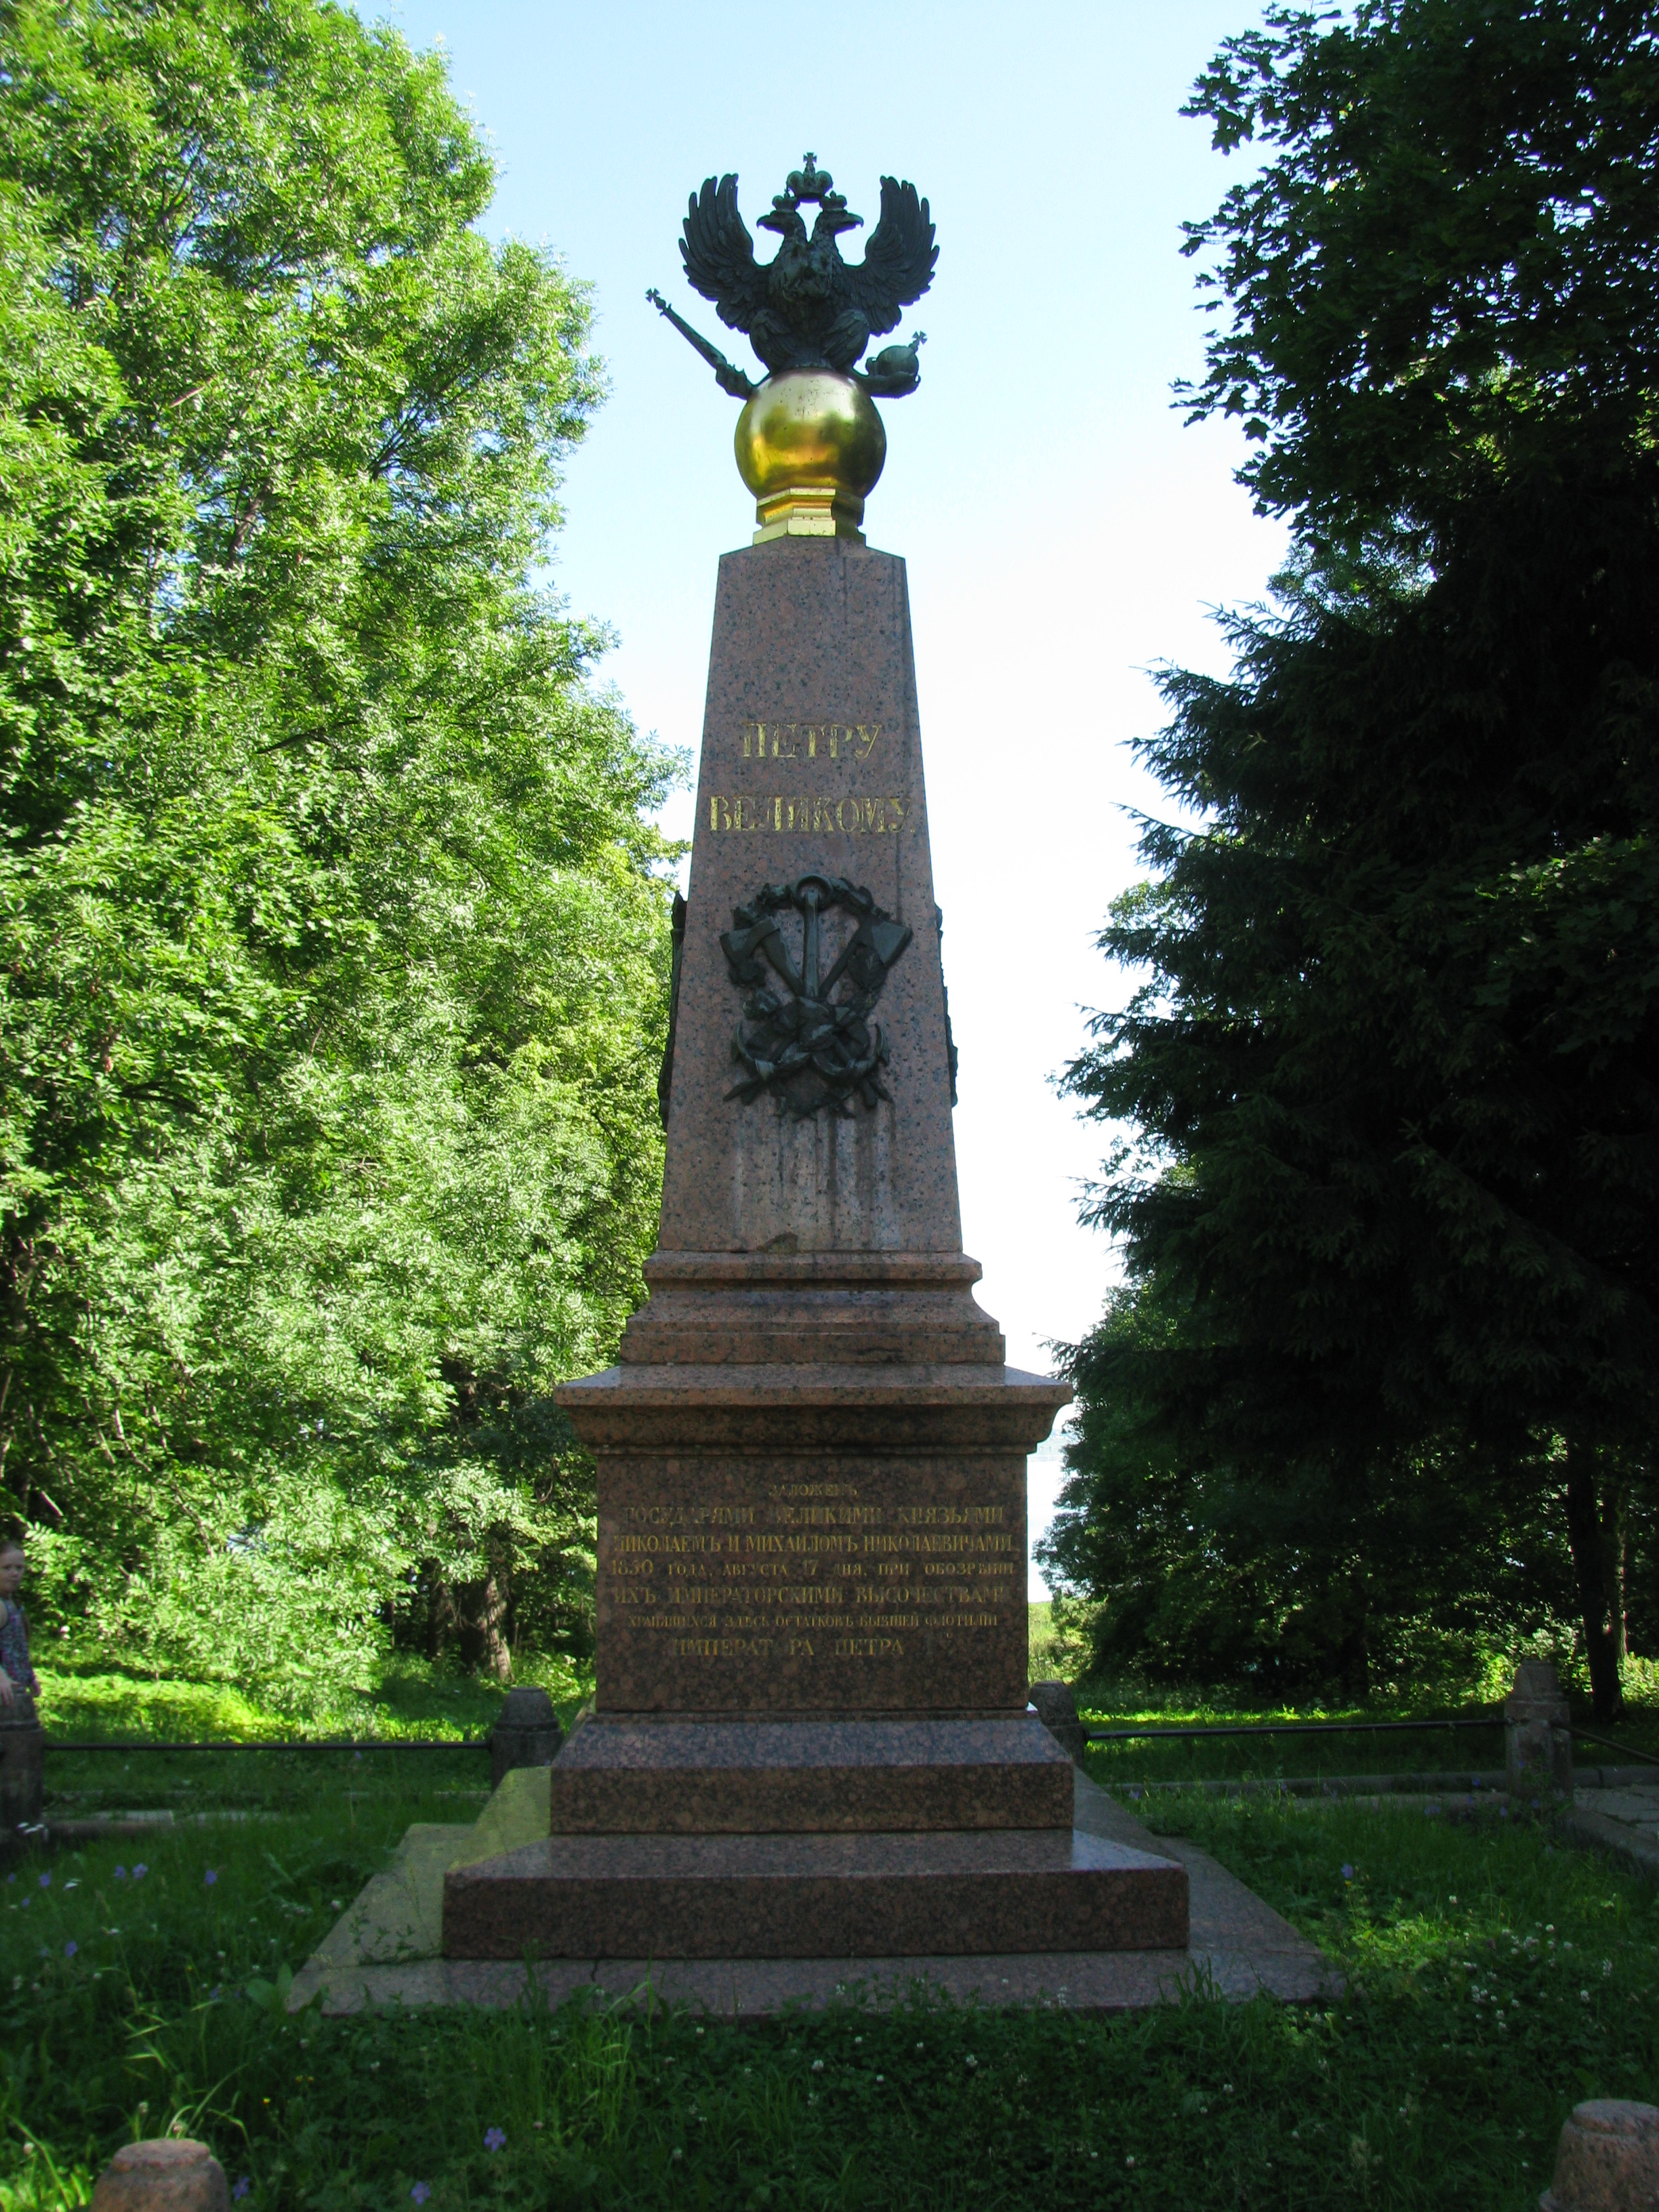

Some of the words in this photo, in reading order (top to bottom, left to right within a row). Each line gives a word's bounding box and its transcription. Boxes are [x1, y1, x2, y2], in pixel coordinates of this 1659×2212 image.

[741, 723, 882, 758] ПЕТРУ
[898, 1507, 1004, 1524] КНЯЗЬЯМИ
[613, 1534, 722, 1553] НИКОЛАЕМЪ
[729, 1534, 740, 1553] И
[745, 1534, 859, 1553] МИХАИЛОМЪ
[611, 1559, 654, 1576] 1850
[722, 1563, 788, 1577] АВГУСТА
[803, 1559, 819, 1576] 17
[878, 1562, 910, 1576] ПРИ
[613, 1586, 657, 1604] ИХЪ
[672, 1638, 815, 1656] ИМПЕРАТРА
[834, 1638, 905, 1656] ПЕТРА
